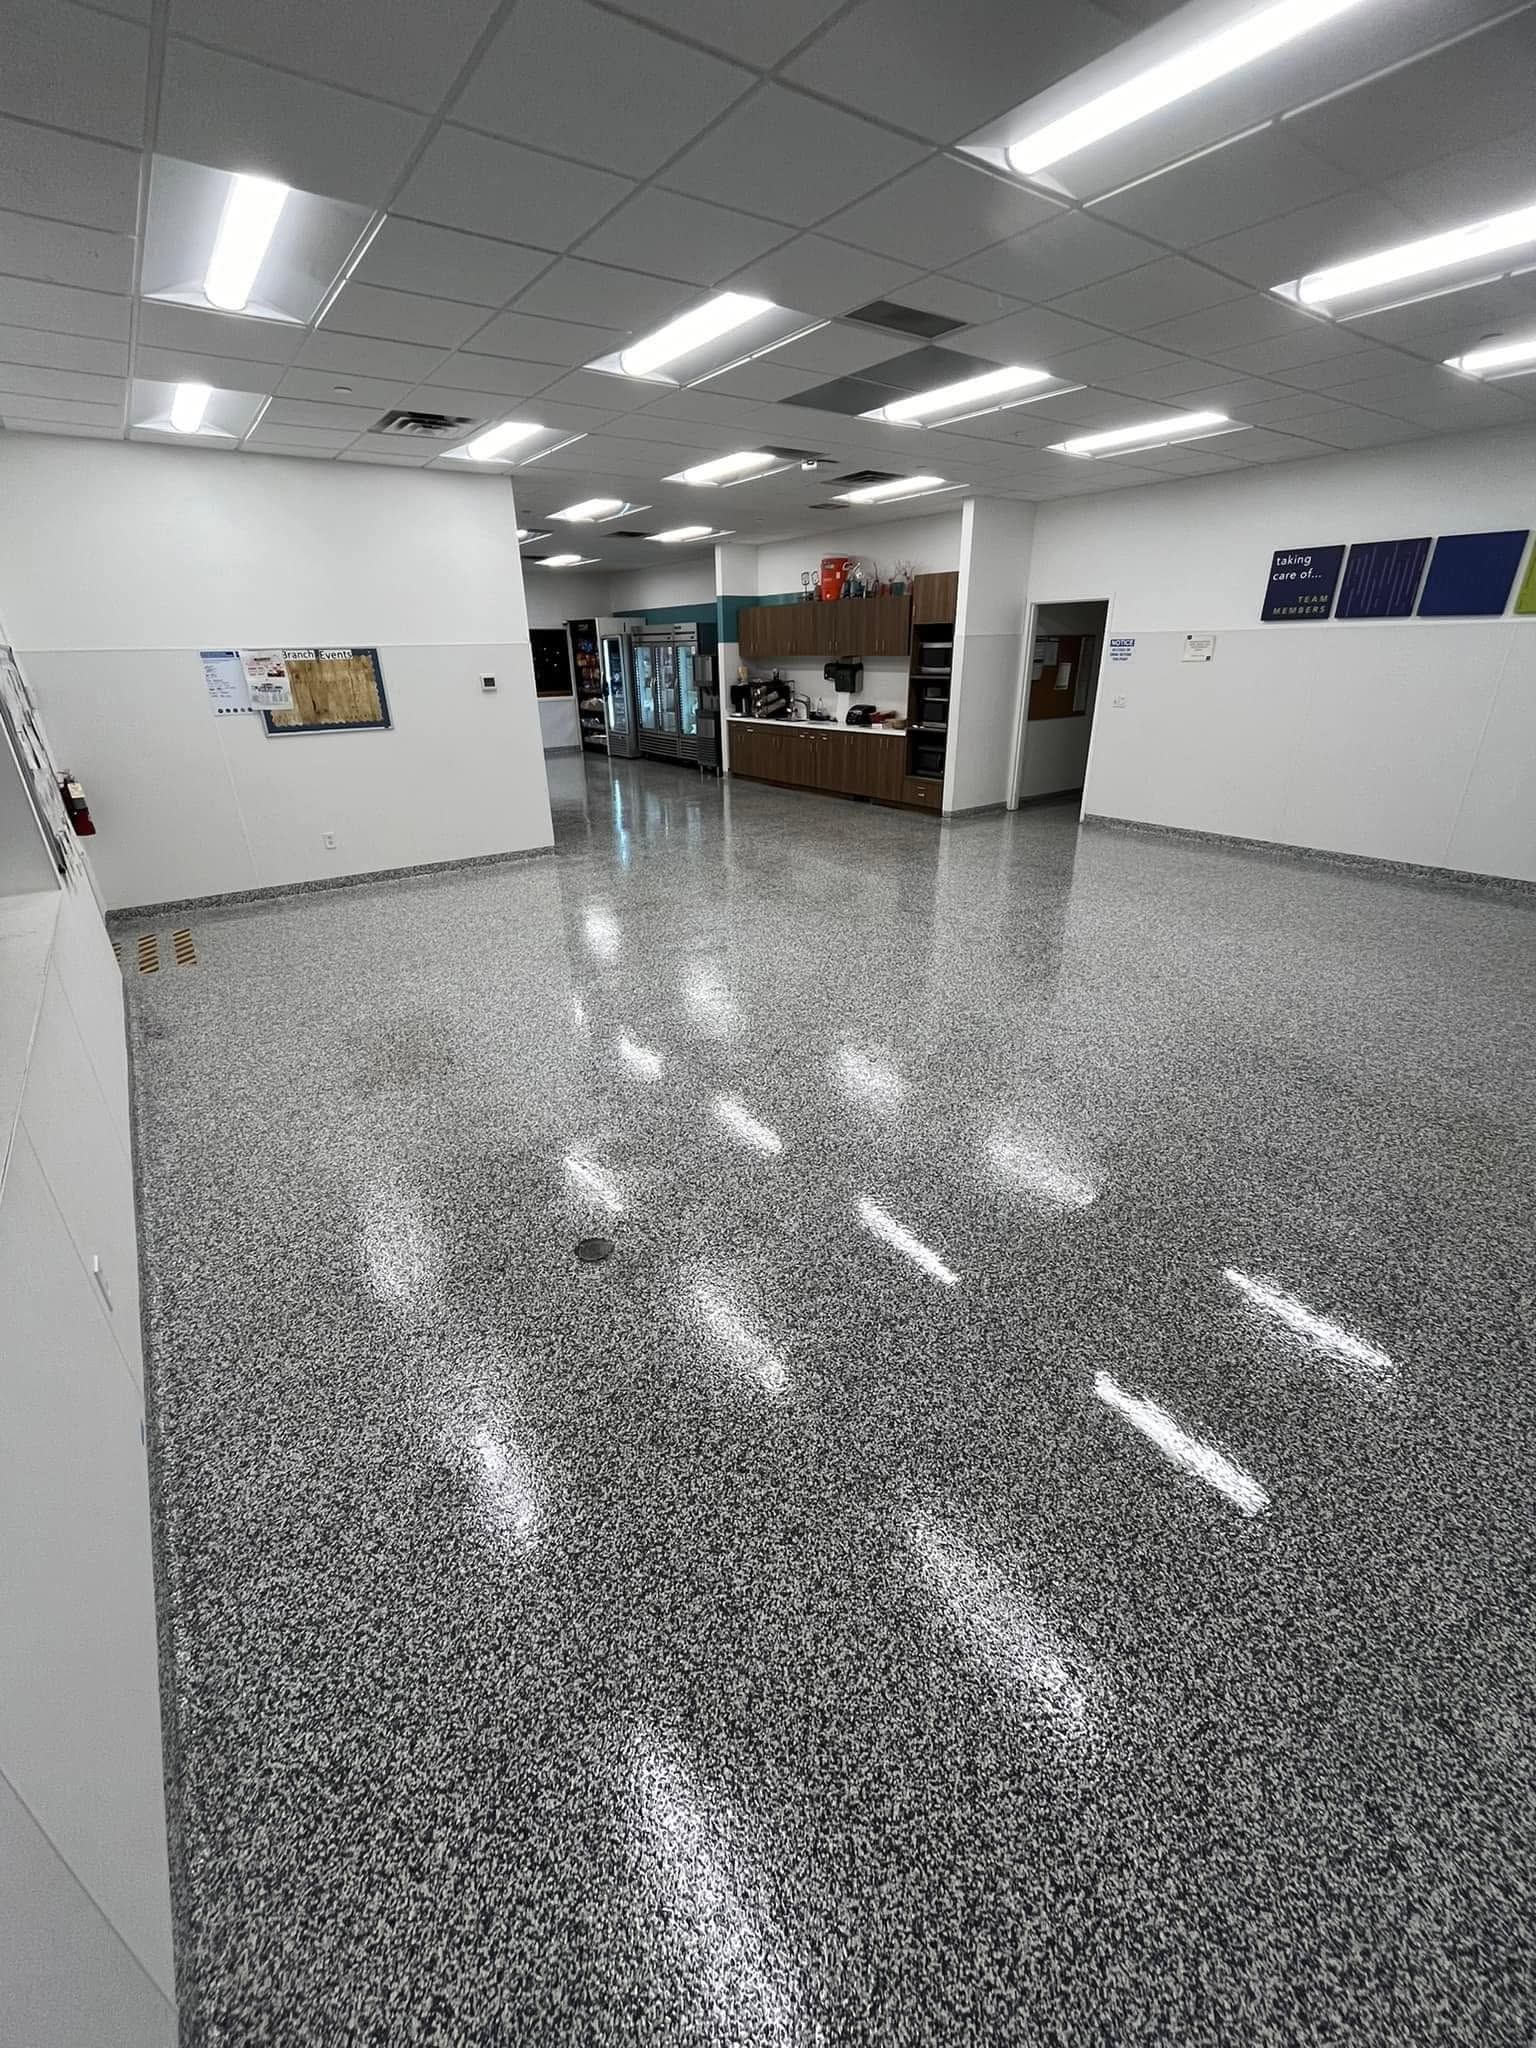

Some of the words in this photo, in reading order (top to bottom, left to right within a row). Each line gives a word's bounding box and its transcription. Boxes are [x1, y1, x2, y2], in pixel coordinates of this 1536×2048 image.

[1276, 555, 1312, 567] taking
[1272, 571, 1297, 581] care
[1300, 567, 1322, 579] of...
[1298, 595, 1329, 603] TEAM
[1272, 605, 1326, 615] MEMBERS
[320, 650, 353, 660] Events
